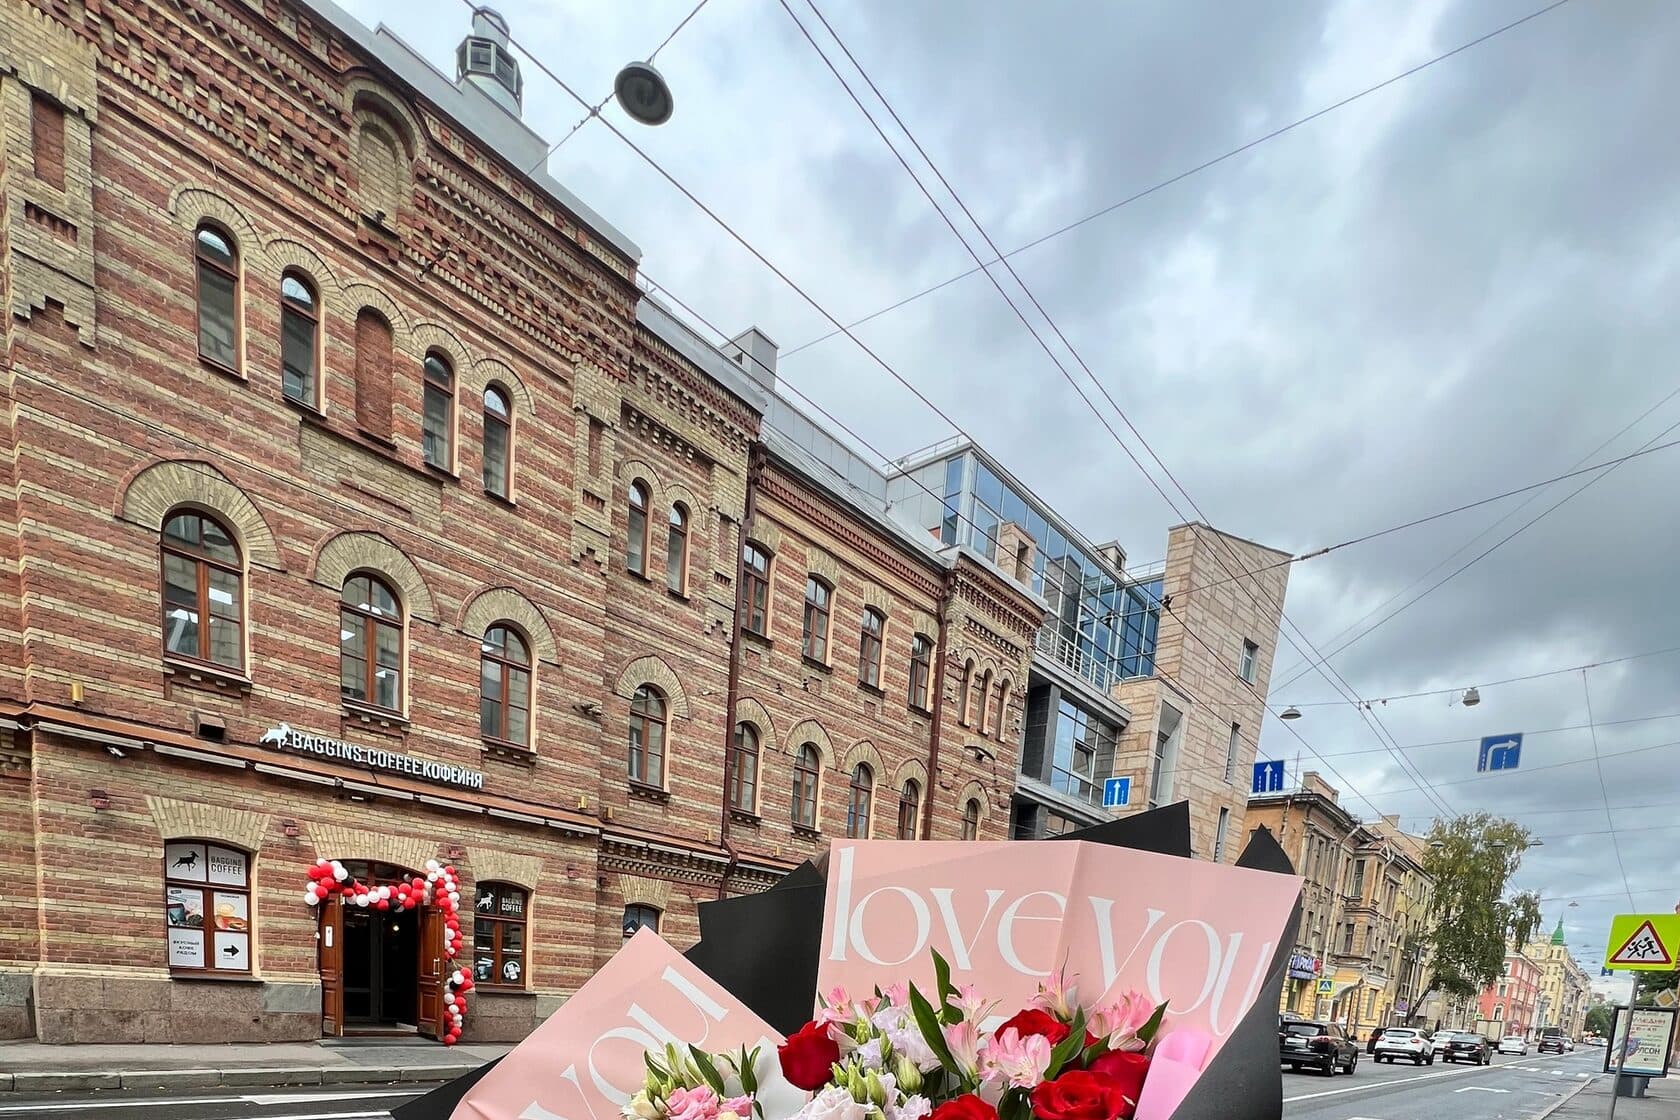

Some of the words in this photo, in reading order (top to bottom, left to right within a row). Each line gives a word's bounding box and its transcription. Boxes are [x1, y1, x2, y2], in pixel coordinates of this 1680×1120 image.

[291, 730, 363, 762] BAGGINS
[366, 748, 423, 775] COFFEE
[422, 763, 484, 789] КОФЕЙНЯ
[210, 855, 243, 867] BAGGINS
[210, 863, 242, 875] COFFEE
[501, 903, 522, 913] COFFEE
[827, 846, 1068, 977] love
[1084, 895, 1272, 1037] you
